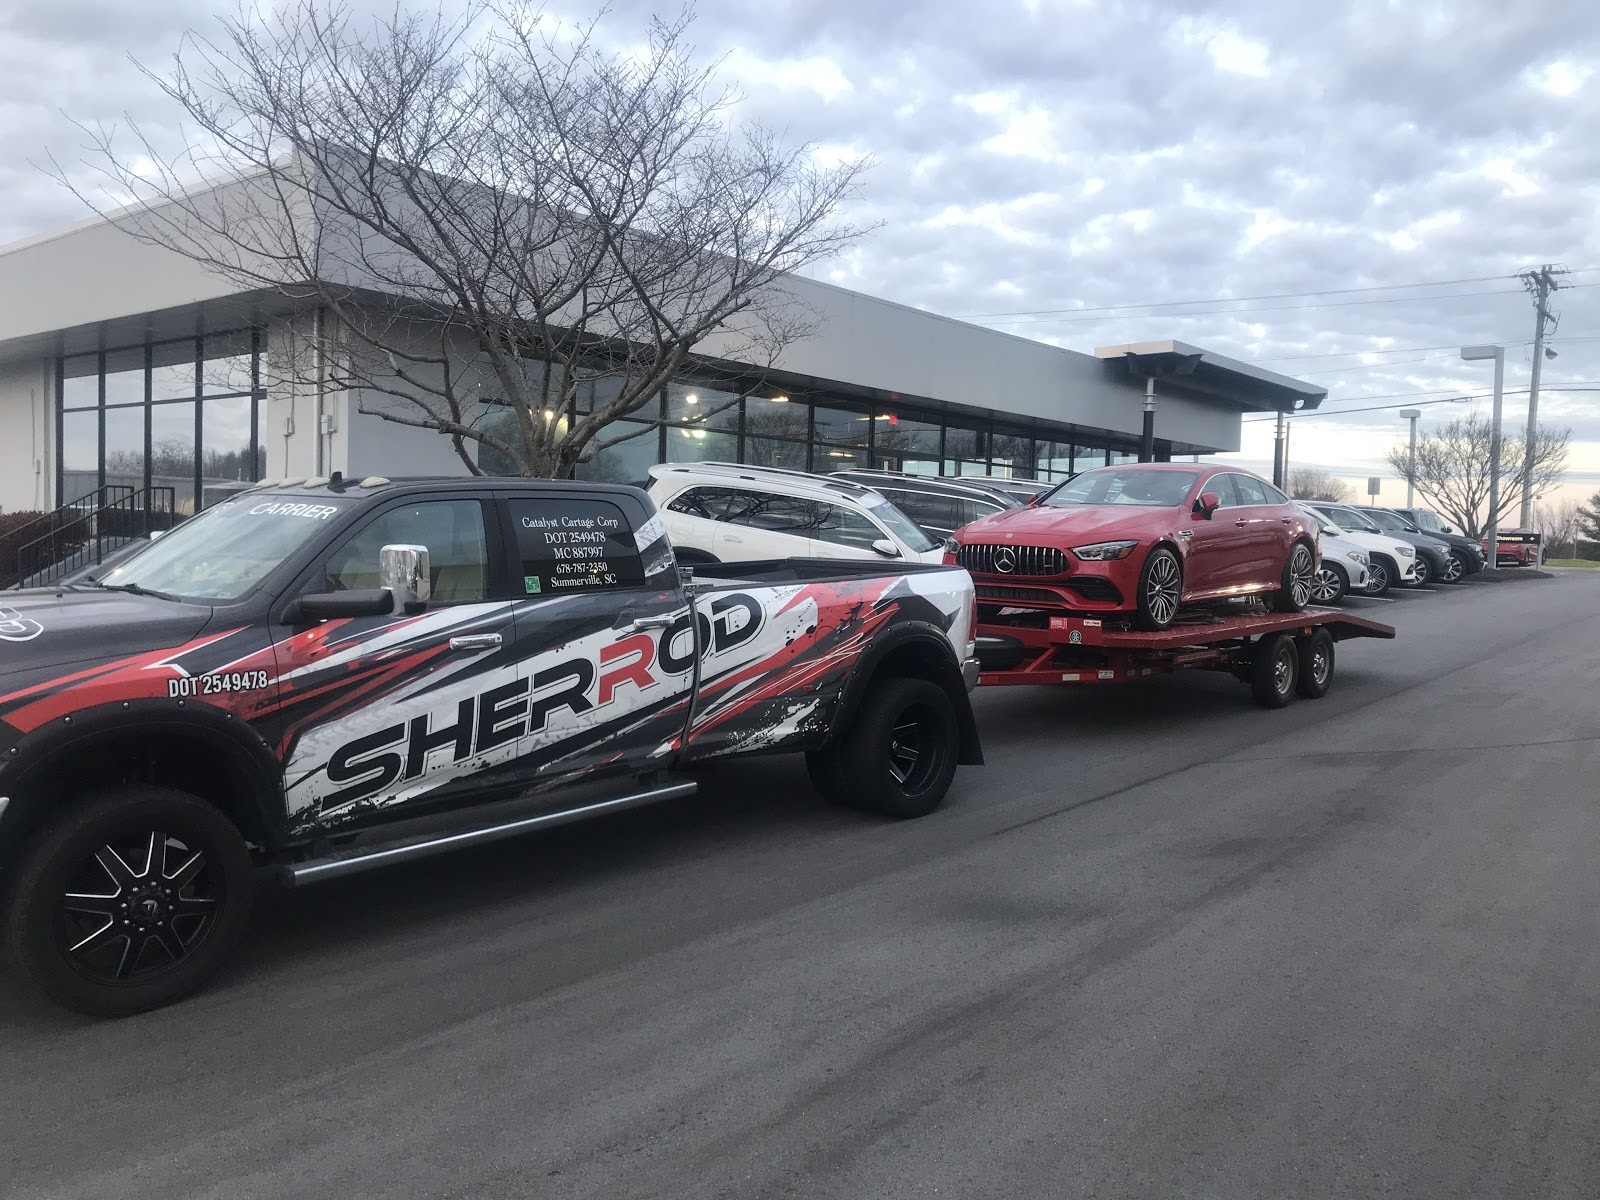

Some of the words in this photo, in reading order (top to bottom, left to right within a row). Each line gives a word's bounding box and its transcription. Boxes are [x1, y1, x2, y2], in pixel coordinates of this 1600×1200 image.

[249, 502, 338, 520] CARRIER
[522, 517, 558, 529] Catalyst
[562, 517, 594, 529] Cartage
[597, 516, 619, 528] Corp
[544, 532, 567, 544] DOT
[569, 531, 606, 543] 2549478
[553, 547, 572, 560] MC
[573, 546, 604, 559] 887997
[556, 561, 608, 574] 678-787-2350
[550, 574, 603, 588] Summerville,
[604, 573, 617, 585] SC
[168, 676, 199, 698] DOT
[202, 670, 268, 694] 2549478
[320, 593, 766, 813] SHERROD
